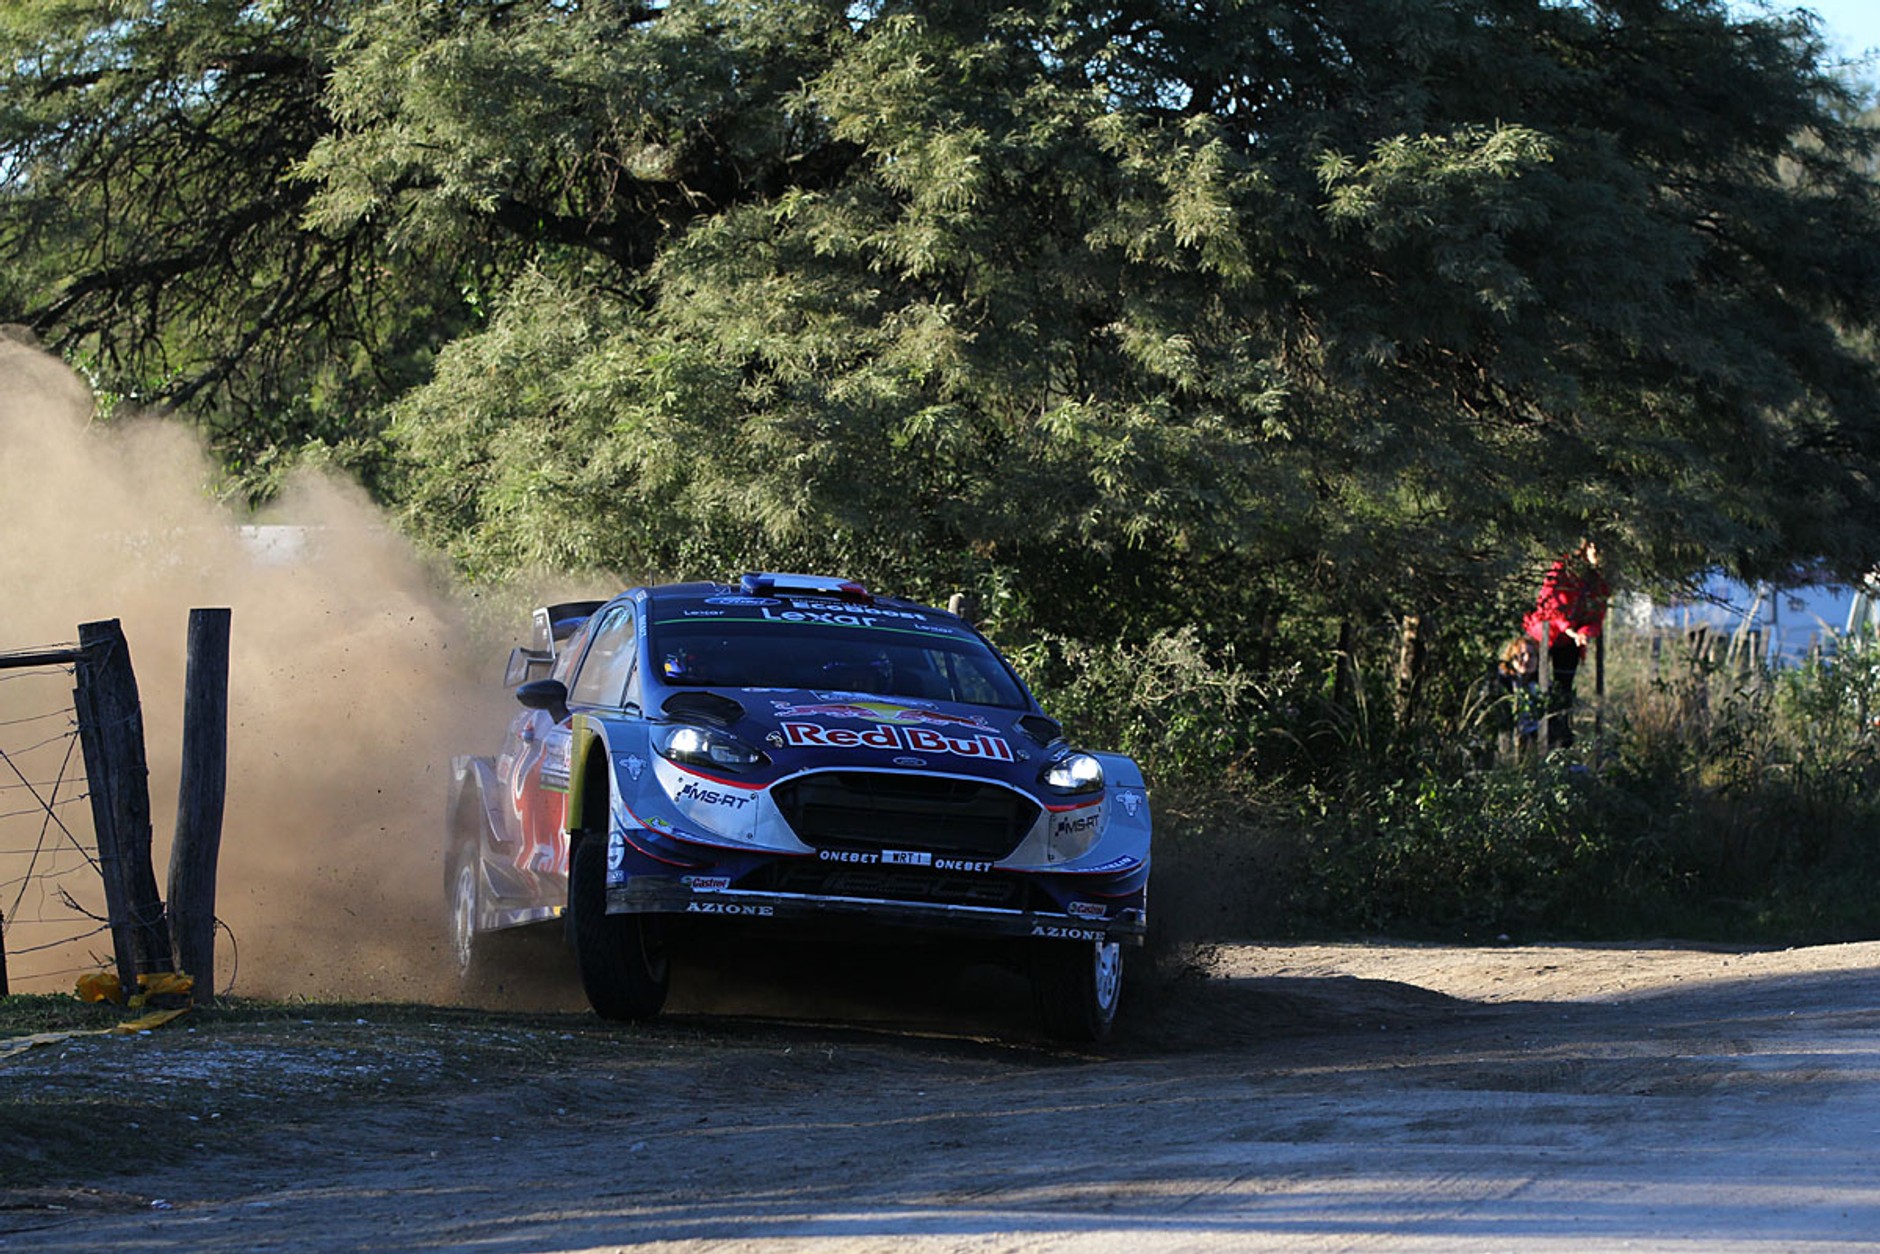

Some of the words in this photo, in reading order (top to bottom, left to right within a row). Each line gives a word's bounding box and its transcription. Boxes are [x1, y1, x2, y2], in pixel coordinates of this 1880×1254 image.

[761, 607, 877, 627] Lexar
[783, 722, 902, 749] Red
[904, 728, 1013, 760] Bull
[819, 850, 879, 864] ONEBET
[934, 859, 993, 872] ONEBET
[693, 878, 727, 888] Castrol
[685, 902, 774, 916] AZIONE
[1030, 926, 1106, 941] AZIONE
